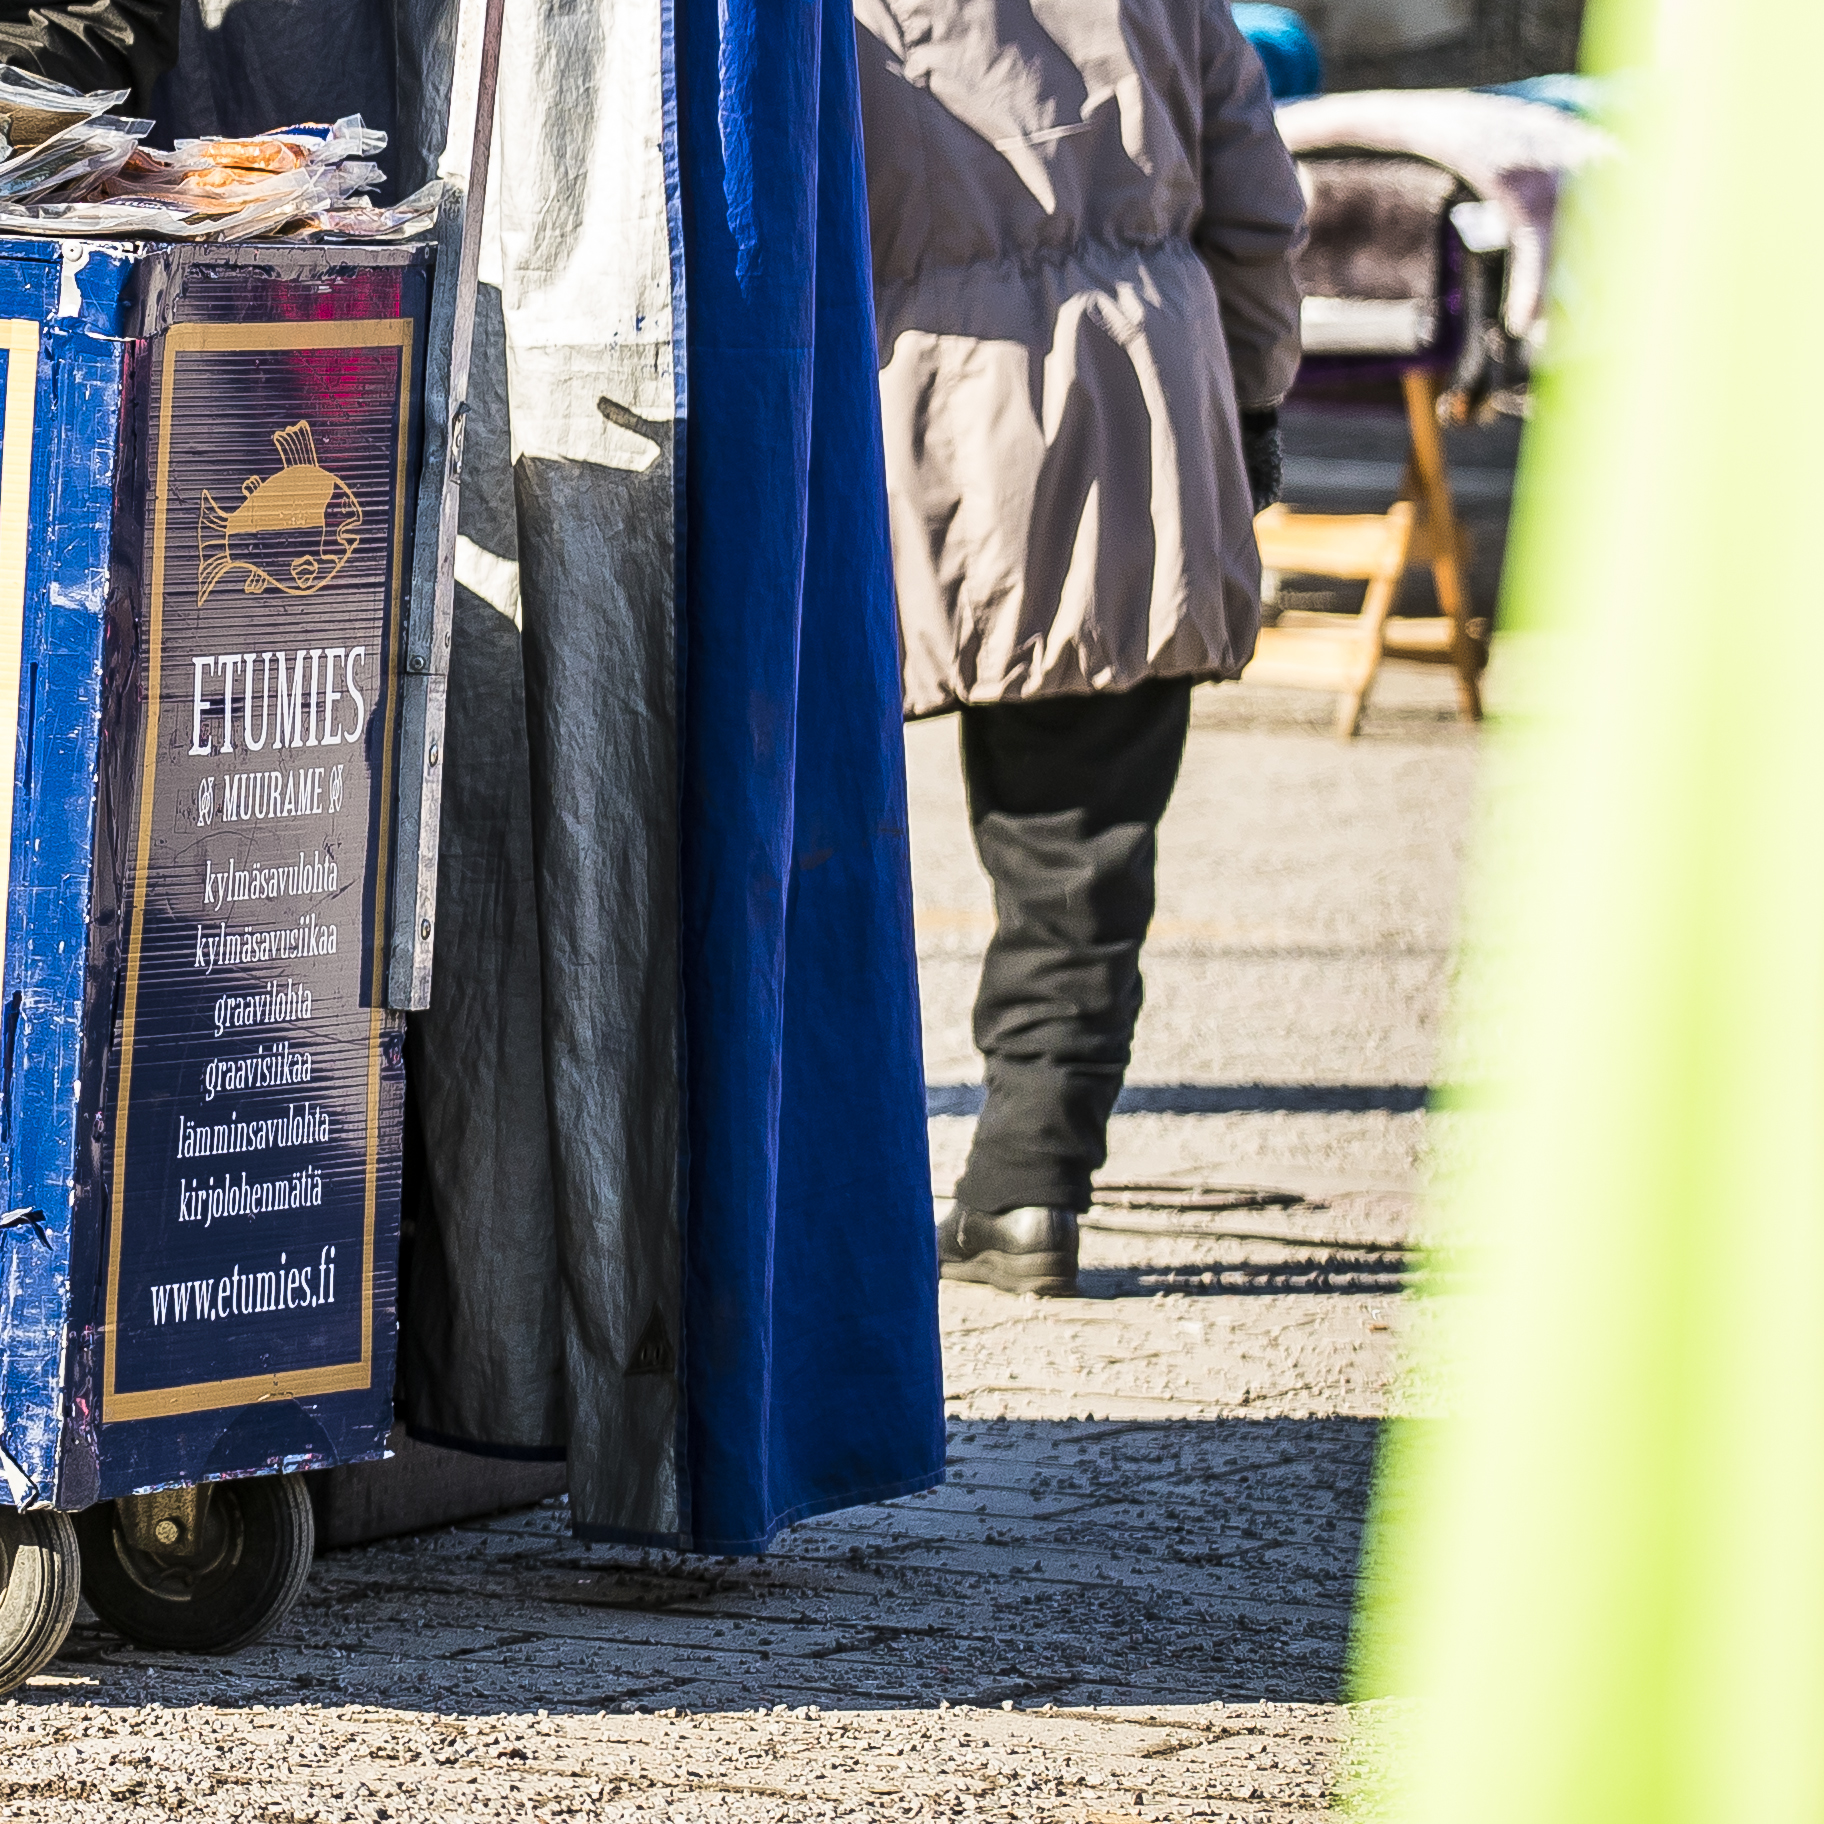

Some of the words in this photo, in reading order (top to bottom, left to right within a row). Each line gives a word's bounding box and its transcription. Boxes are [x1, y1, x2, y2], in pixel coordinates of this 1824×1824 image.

[188, 645, 366, 756] ETUMIES
[221, 767, 325, 823] MUURAME
[203, 850, 338, 912] kylmäsavulohta
[193, 913, 338, 976] kylmäsavusiikaa
[214, 978, 313, 1038] graavilohta
[205, 1041, 313, 1102] graavisiikaa
[176, 1102, 330, 1159] lämminsavulohta
[178, 1165, 322, 1228] kirjolohenmätiä
[151, 1245, 336, 1326] www.etumies.fi
